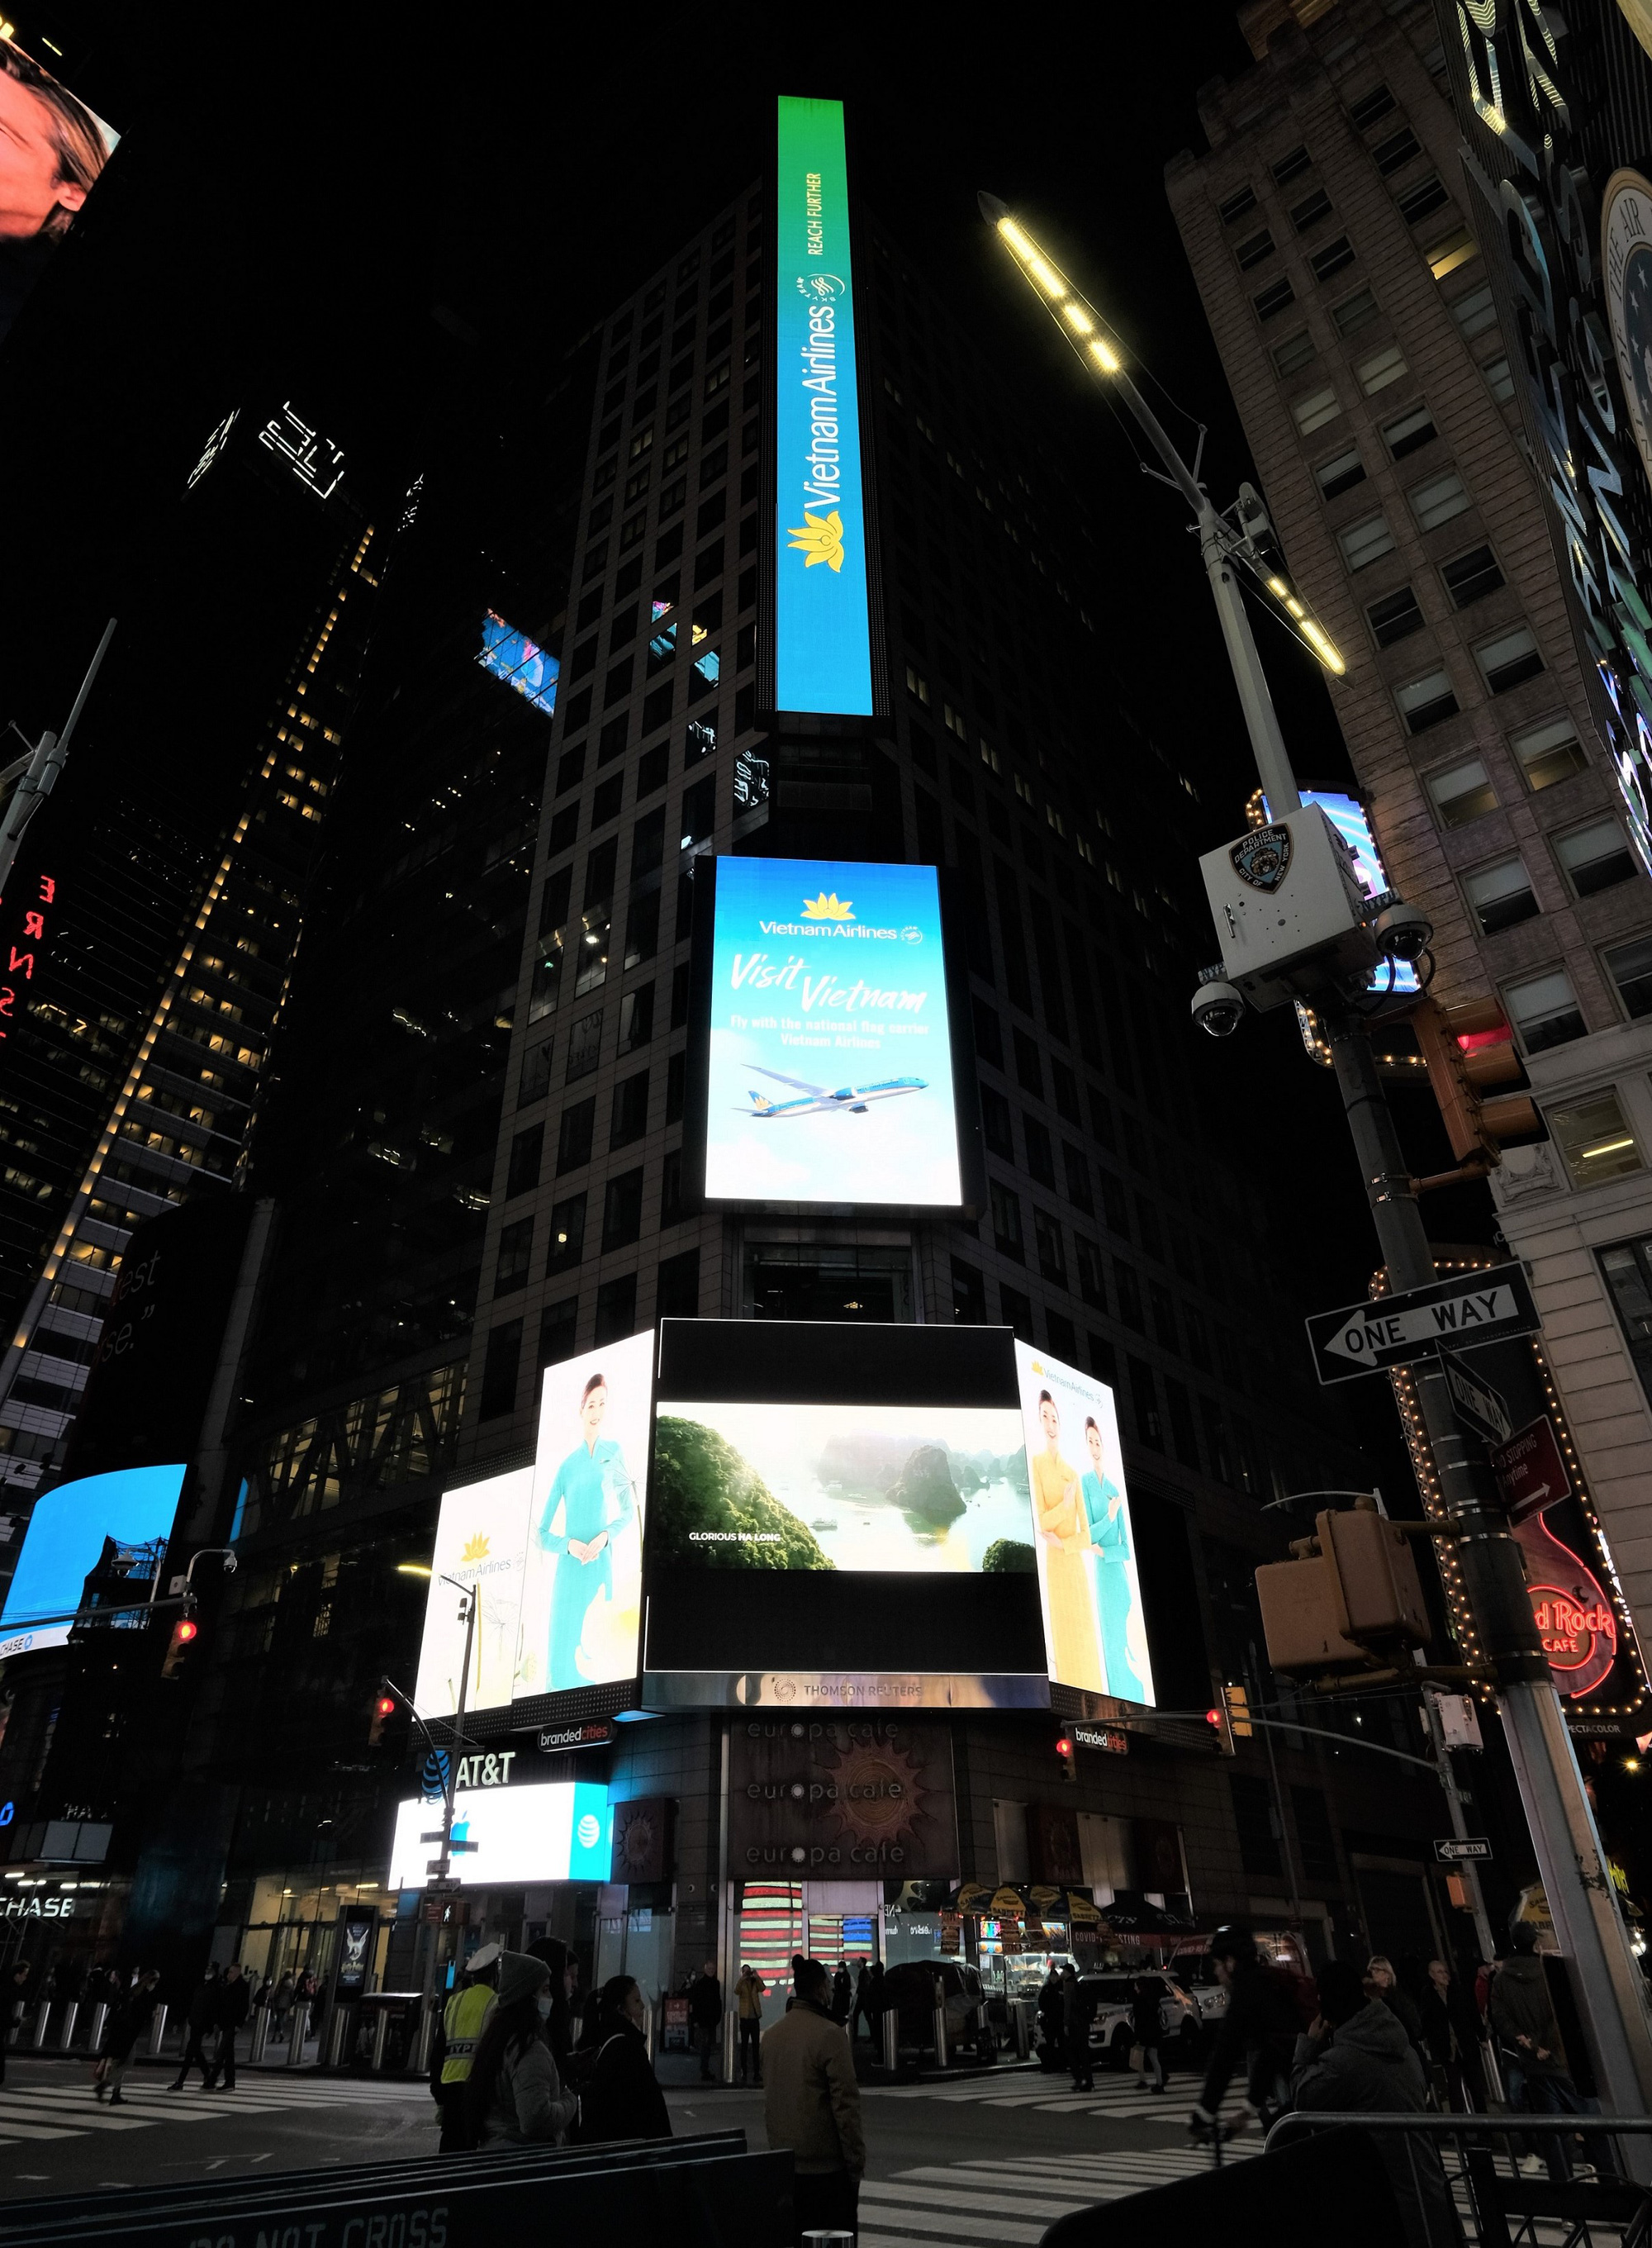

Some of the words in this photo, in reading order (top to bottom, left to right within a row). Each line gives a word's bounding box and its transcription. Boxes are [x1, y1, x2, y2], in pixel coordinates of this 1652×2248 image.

[806, 173, 823, 220] FURTHER
[808, 221, 824, 256] REACH
[1609, 226, 1626, 302] THE
[1621, 197, 1645, 243] AIR
[800, 306, 837, 396] Airlines
[803, 397, 841, 509] Vietnam
[1235, 833, 1287, 864] DEPARTMENT
[1241, 829, 1275, 848] POLICE
[1238, 867, 1255, 882] CITY
[1252, 879, 1265, 887] OF
[1274, 861, 1287, 882] NEW
[1282, 843, 1290, 863] YORK
[1362, 891, 1396, 913] NYPD
[760, 920, 831, 937] Vietnam
[833, 924, 897, 940] Airlines
[731, 953, 810, 990] Visit
[800, 975, 928, 1013] Vietnam
[731, 1015, 748, 1029] Fly
[752, 1015, 777, 1029] with
[781, 1017, 801, 1029] the
[805, 1019, 857, 1033] national
[862, 1020, 885, 1035] flag
[889, 1023, 930, 1034] carrier
[781, 1034, 831, 1047] Vietnam
[835, 1036, 881, 1048] Airlines
[1345, 1316, 1406, 1353] ONE
[1431, 1291, 1498, 1332] WAY
[1043, 1368, 1071, 1390] Vietnam
[1071, 1382, 1094, 1402] Airlines
[1455, 1375, 1479, 1414] ONE
[1483, 1398, 1507, 1437] WAY
[1507, 1433, 1538, 1464] STOPPING
[1503, 1462, 1529, 1486] Anytime
[689, 1532, 738, 1542] GLORIOUS
[738, 1533, 753, 1542] HA
[754, 1533, 781, 1542] LONG
[475, 1559, 511, 1577] Airlines
[1552, 1599, 1616, 1638] Rock
[1542, 1637, 1579, 1653] CAFE
[804, 1685, 865, 1697] THOMSON
[869, 1685, 923, 1697] REUTERS
[1567, 1724, 1621, 1734] PECTACOLOR
[456, 1751, 517, 1789] AT&T
[1444, 1846, 1460, 1855] ONE
[1466, 1845, 1483, 1853] WAY
[341, 2207, 450, 2248] CROSS
